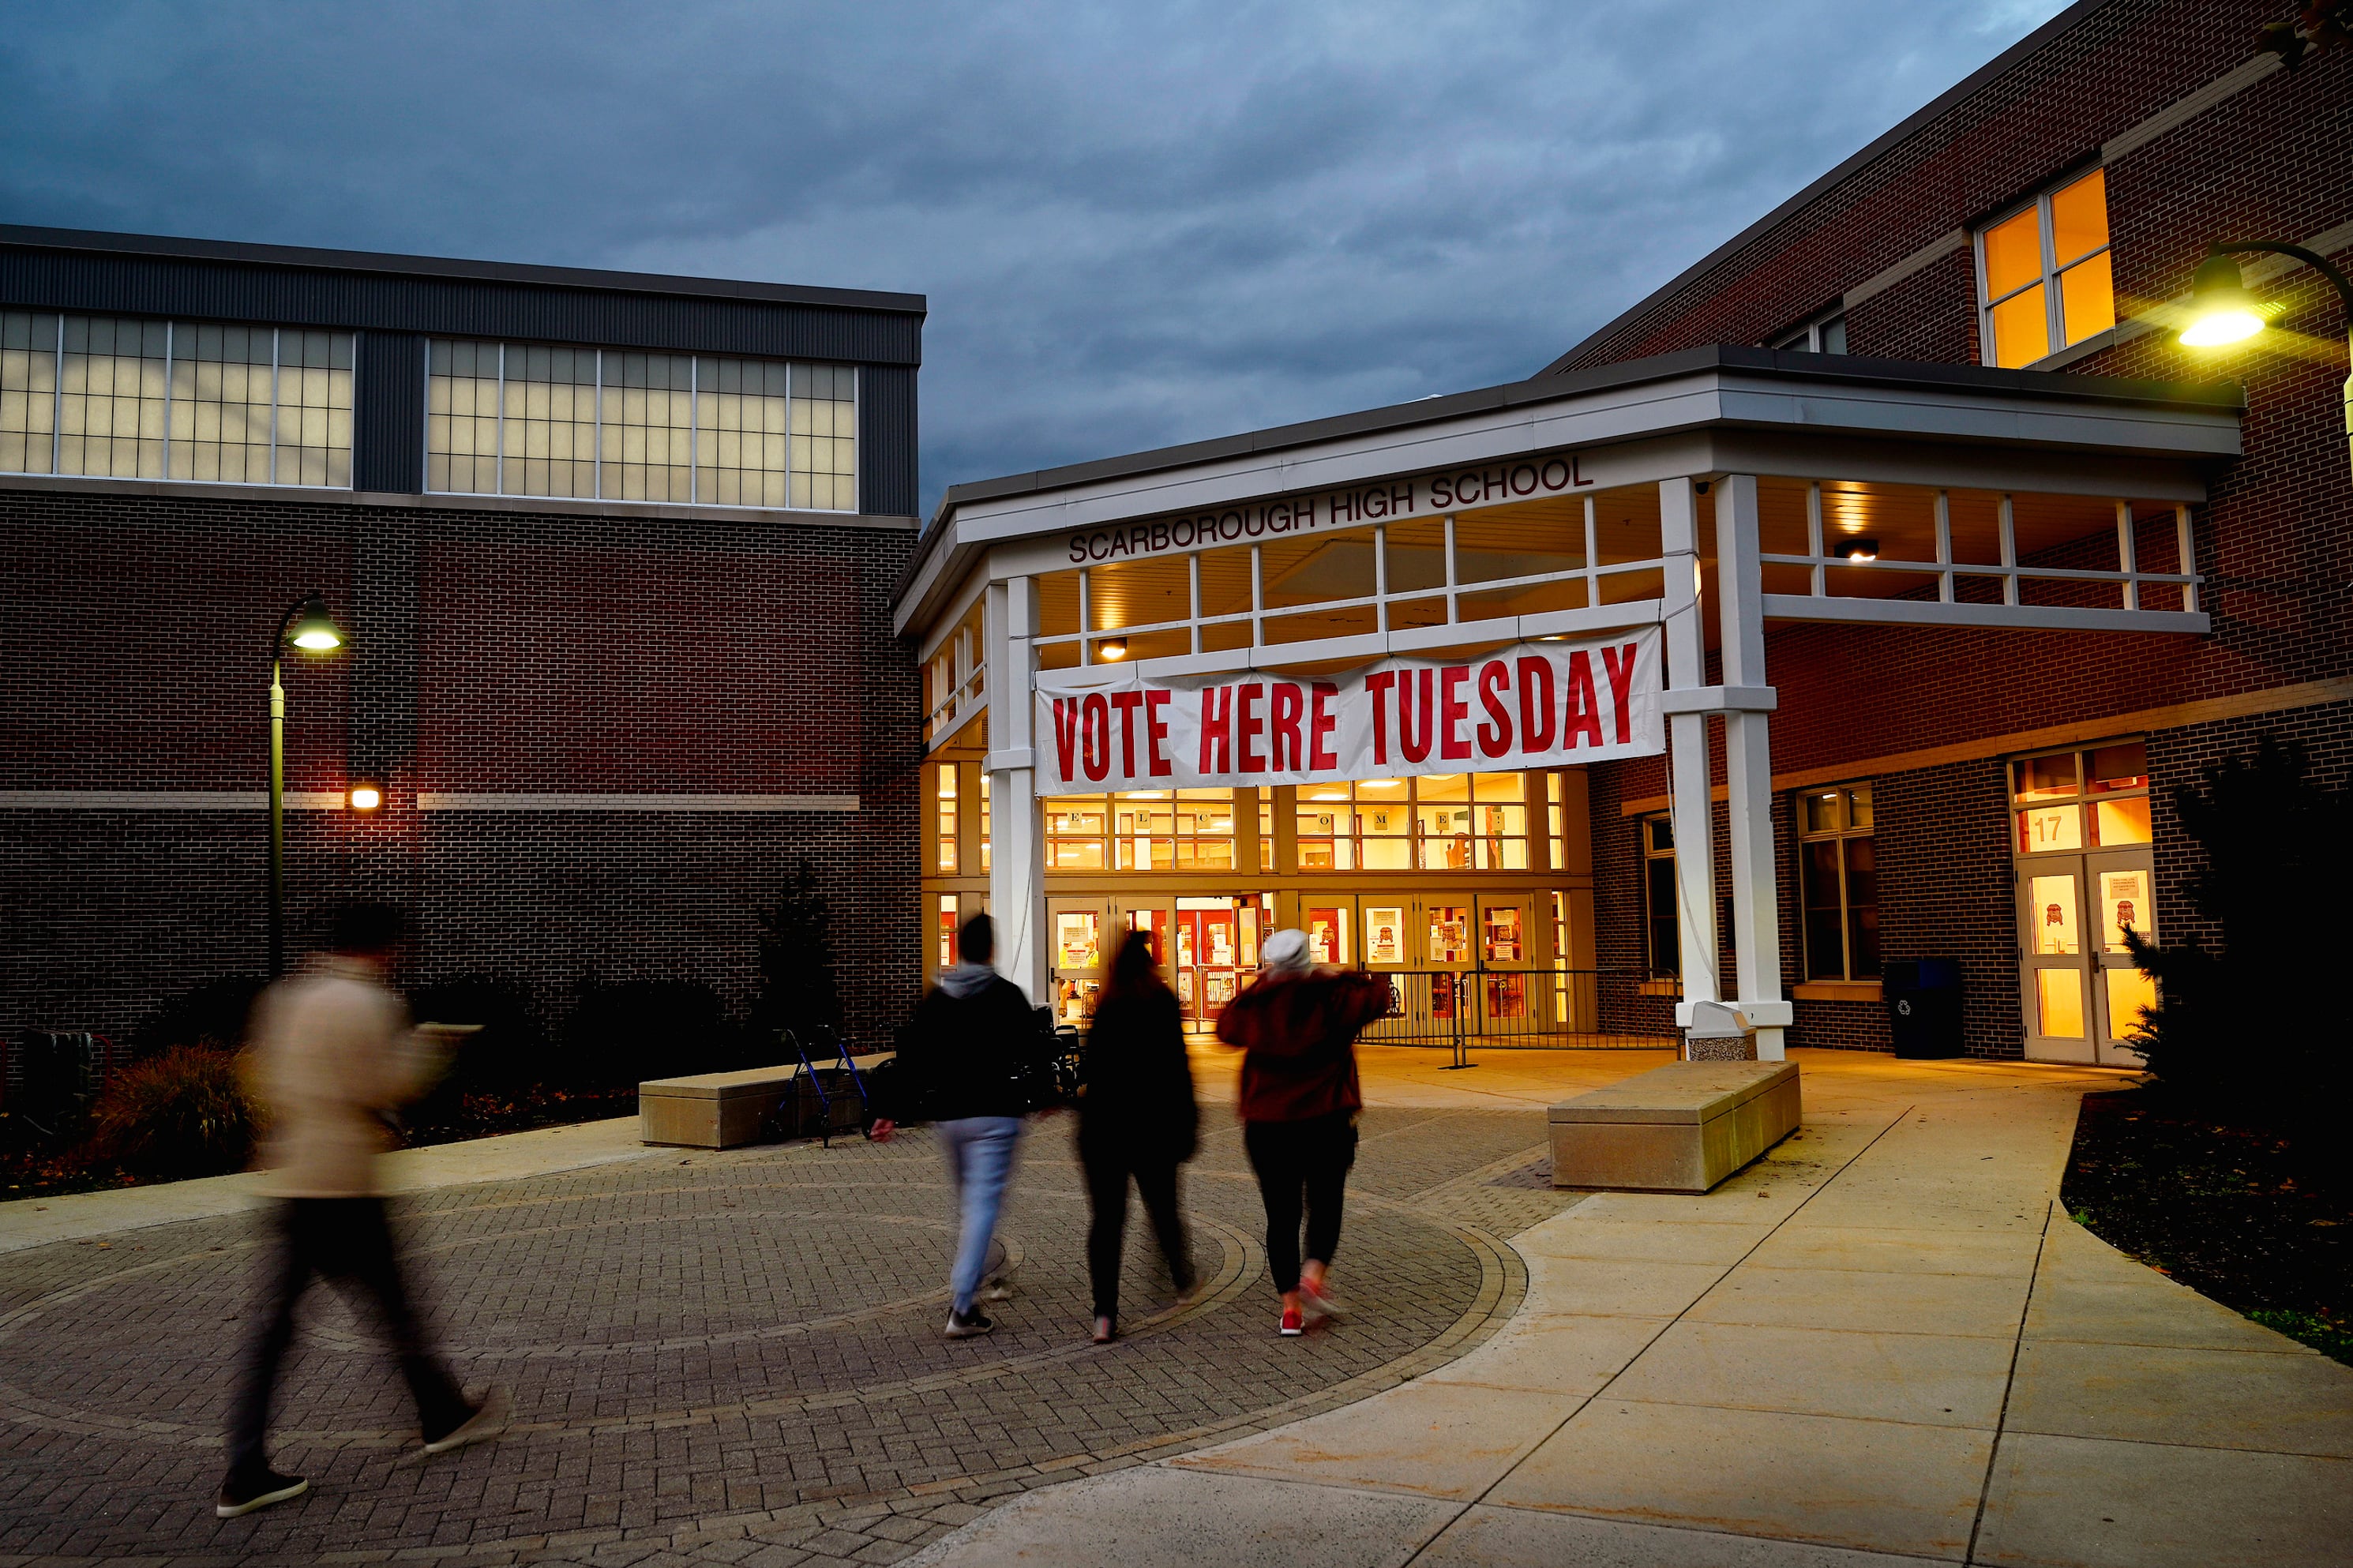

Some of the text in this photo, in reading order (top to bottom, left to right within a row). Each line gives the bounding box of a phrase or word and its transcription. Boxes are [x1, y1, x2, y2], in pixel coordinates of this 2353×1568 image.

[1068, 456, 1593, 563] SCARBOROUGH HIGH SCHOOL
[1053, 642, 1638, 783] VOTE HERE TUESDAY
[2035, 816, 2062, 842] 17
